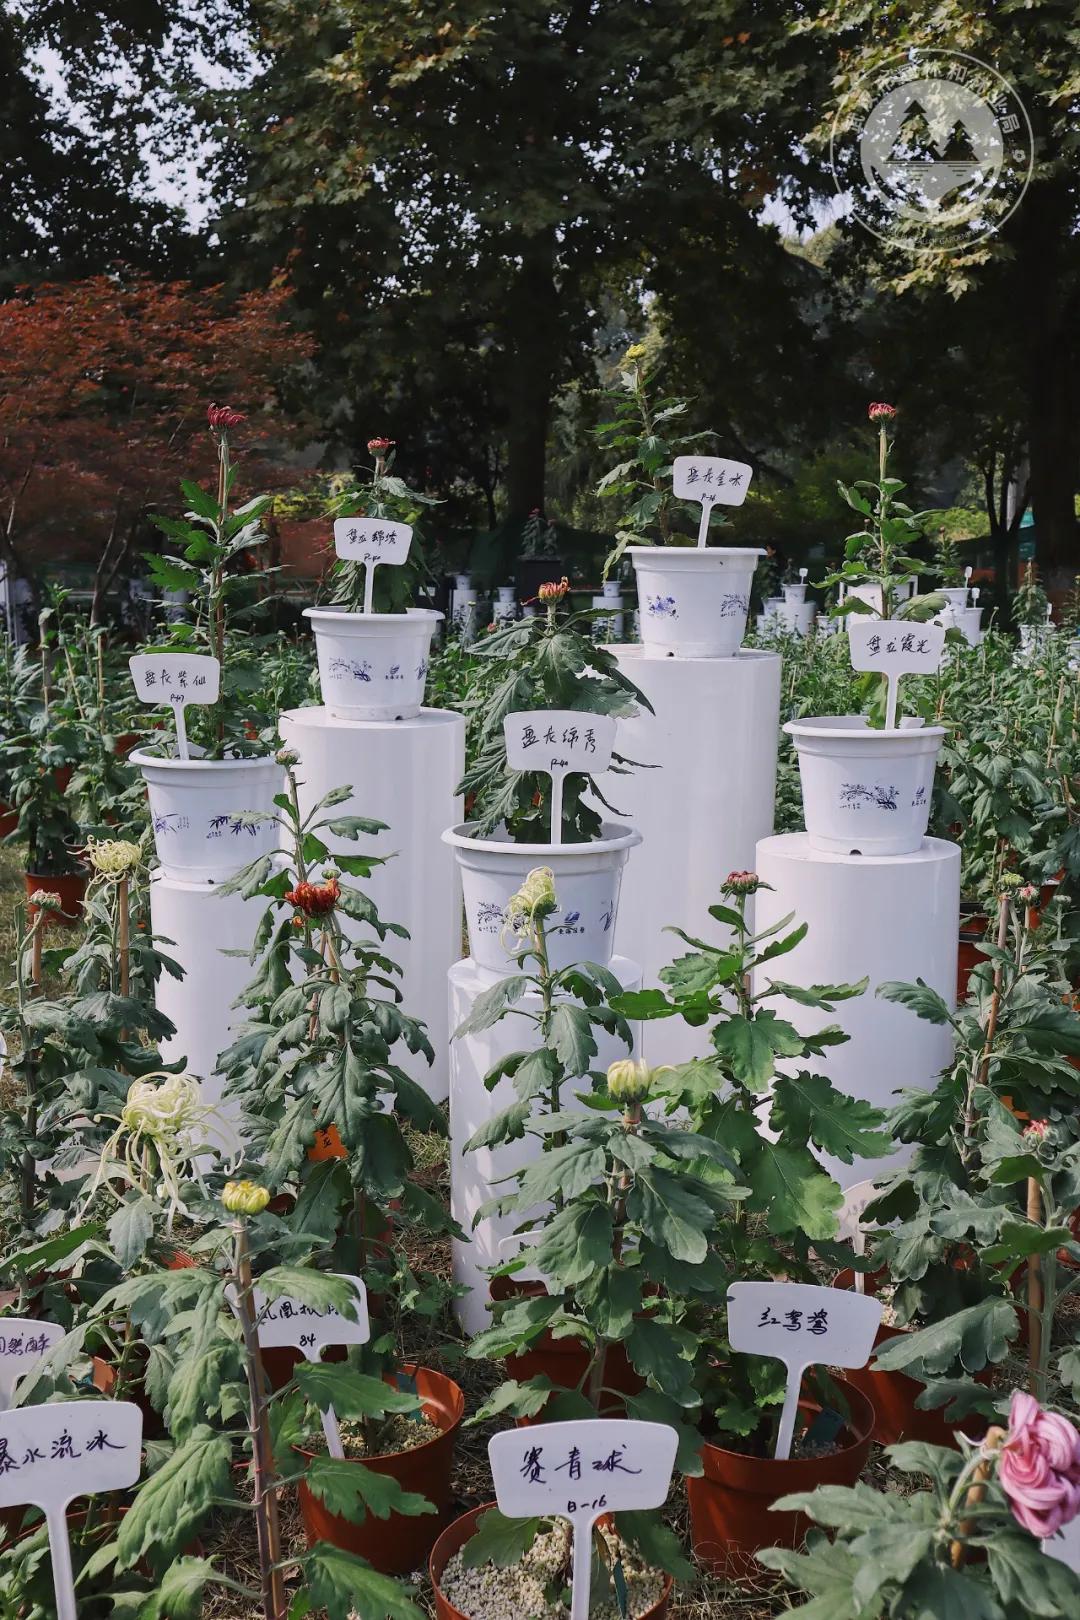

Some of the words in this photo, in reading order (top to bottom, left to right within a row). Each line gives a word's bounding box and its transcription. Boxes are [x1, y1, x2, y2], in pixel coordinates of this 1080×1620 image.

[299, 1333, 317, 1348] 84
[519, 1444, 643, 1484] 赛青球
